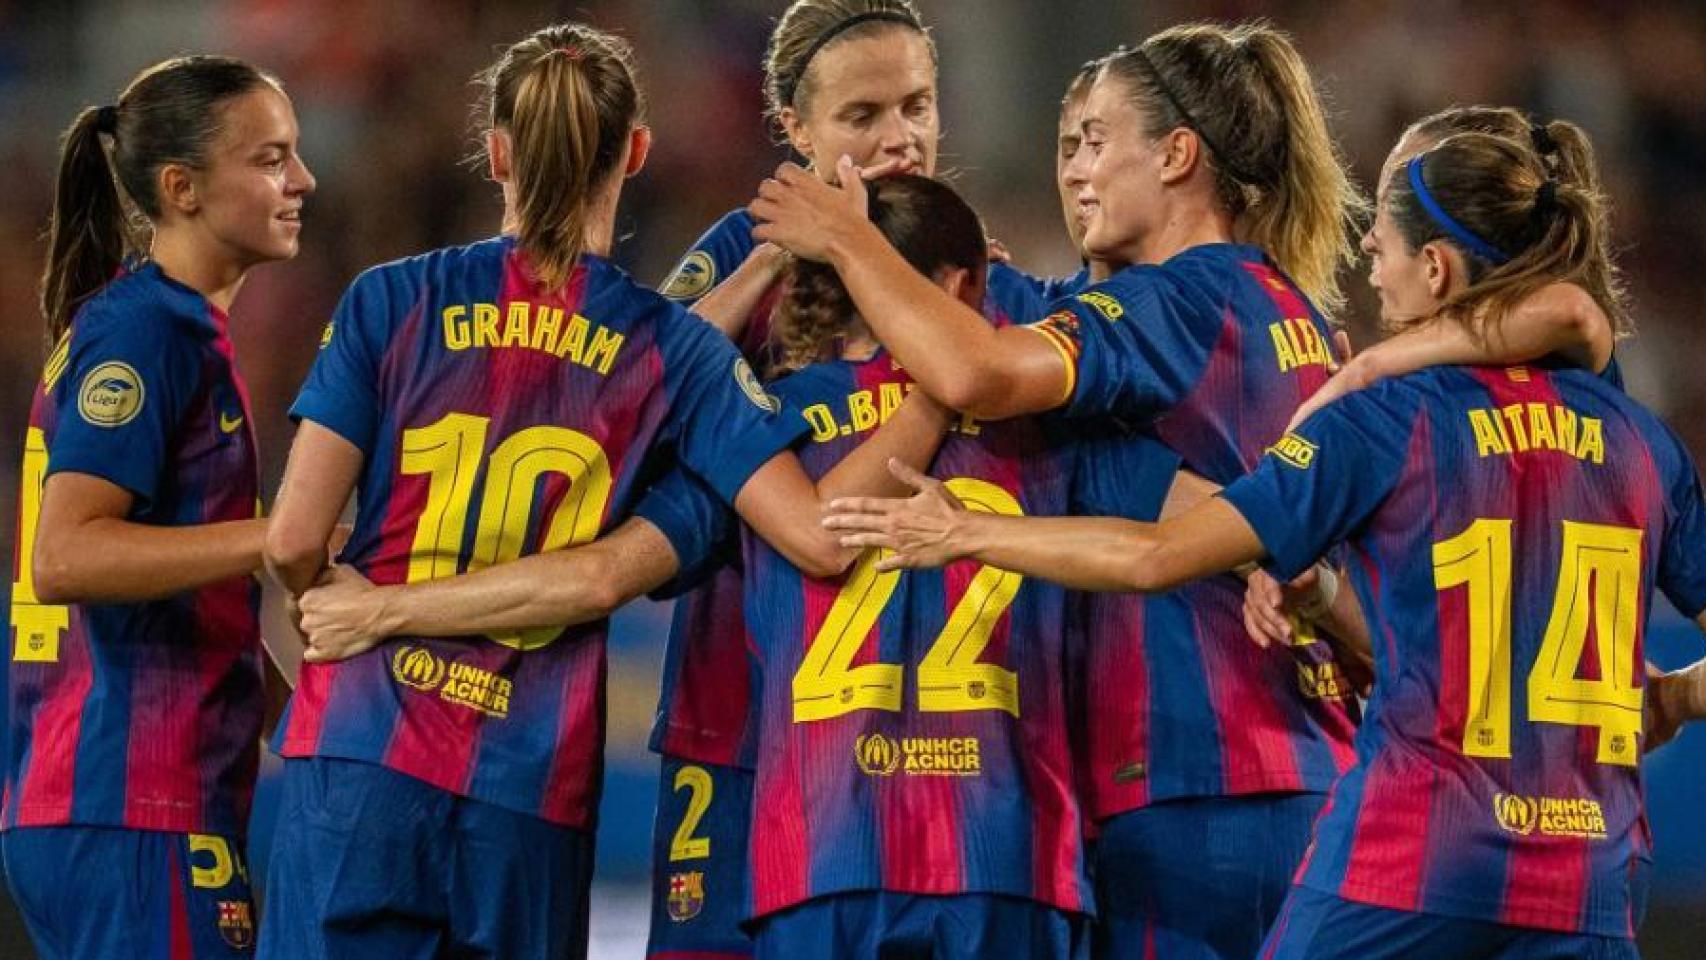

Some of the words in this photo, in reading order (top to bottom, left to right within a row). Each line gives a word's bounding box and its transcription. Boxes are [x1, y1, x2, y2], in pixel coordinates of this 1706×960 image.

[442, 301, 625, 375] GRAHAM
[1468, 403, 1605, 465] AITANA
[401, 411, 613, 650] 10
[792, 477, 1025, 723] 22
[1432, 517, 1644, 767] 14
[441, 678, 509, 712] ACNUR
[448, 661, 512, 697] UNHCR
[902, 737, 980, 754] UNHCR
[904, 754, 980, 769] ACNUR
[673, 765, 713, 862] 2
[1540, 814, 1606, 832] ACNUR
[1541, 797, 1602, 816] UNHCR
